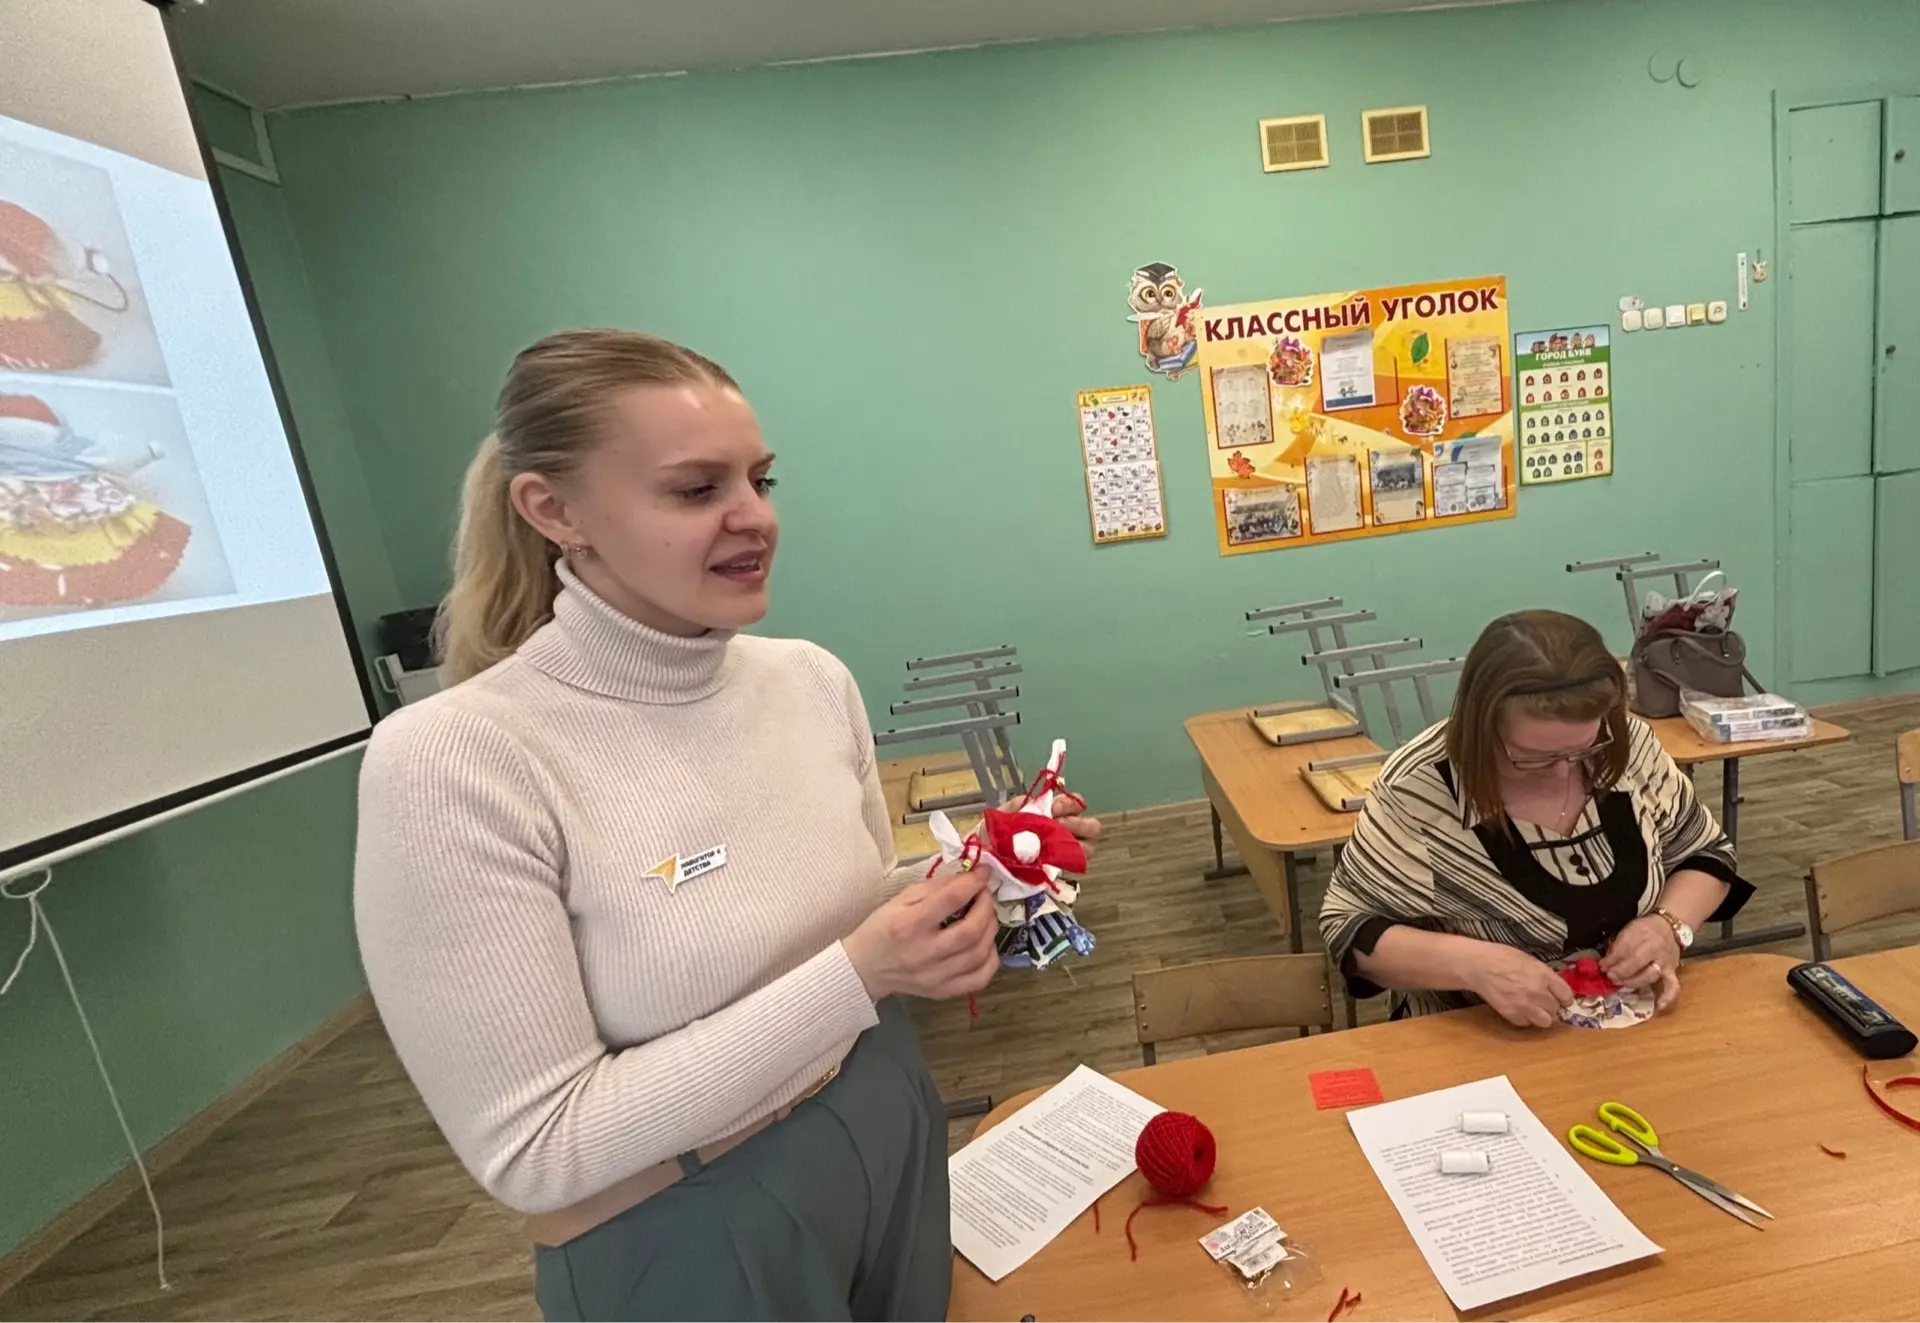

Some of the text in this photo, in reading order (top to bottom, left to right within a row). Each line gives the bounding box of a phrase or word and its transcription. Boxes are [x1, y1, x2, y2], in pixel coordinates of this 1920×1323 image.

[1205, 288, 1499, 342] КЛАССНЫЙ УГОЛОК
[1535, 348, 1592, 361] ГОРОД БУКВ
[681, 850, 715, 869] НАВИГАТОР
[683, 860, 711, 877] ДЕТСТВА
